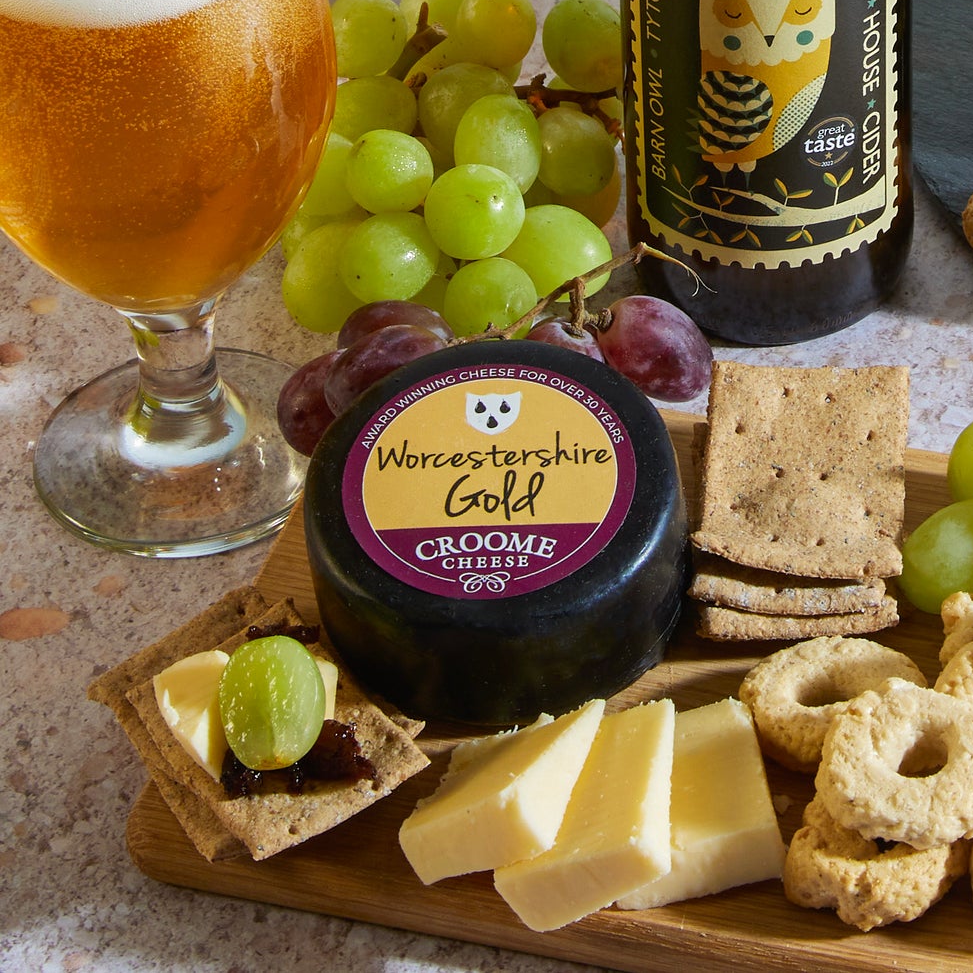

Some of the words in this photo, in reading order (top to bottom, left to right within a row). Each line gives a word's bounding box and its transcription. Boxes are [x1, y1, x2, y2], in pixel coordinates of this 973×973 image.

[862, 9, 881, 97] HOUSE
[648, 67, 664, 116] OWL
[650, 119, 667, 181] BARN
[803, 132, 856, 154] taste
[817, 123, 846, 140] great
[862, 111, 881, 185] CIDER
[361, 407, 398, 450] AWARD
[394, 375, 456, 409] WINNING
[459, 368, 516, 380] CHEESE
[519, 369, 548, 383] FOR
[549, 377, 585, 400] OVER
[582, 395, 599, 410] 30
[597, 407, 625, 445] YEARS
[377, 429, 613, 472] Worcestershire
[444, 469, 545, 522] Gold
[415, 531, 558, 561] CROOME
[441, 555, 530, 570] CHEESE
